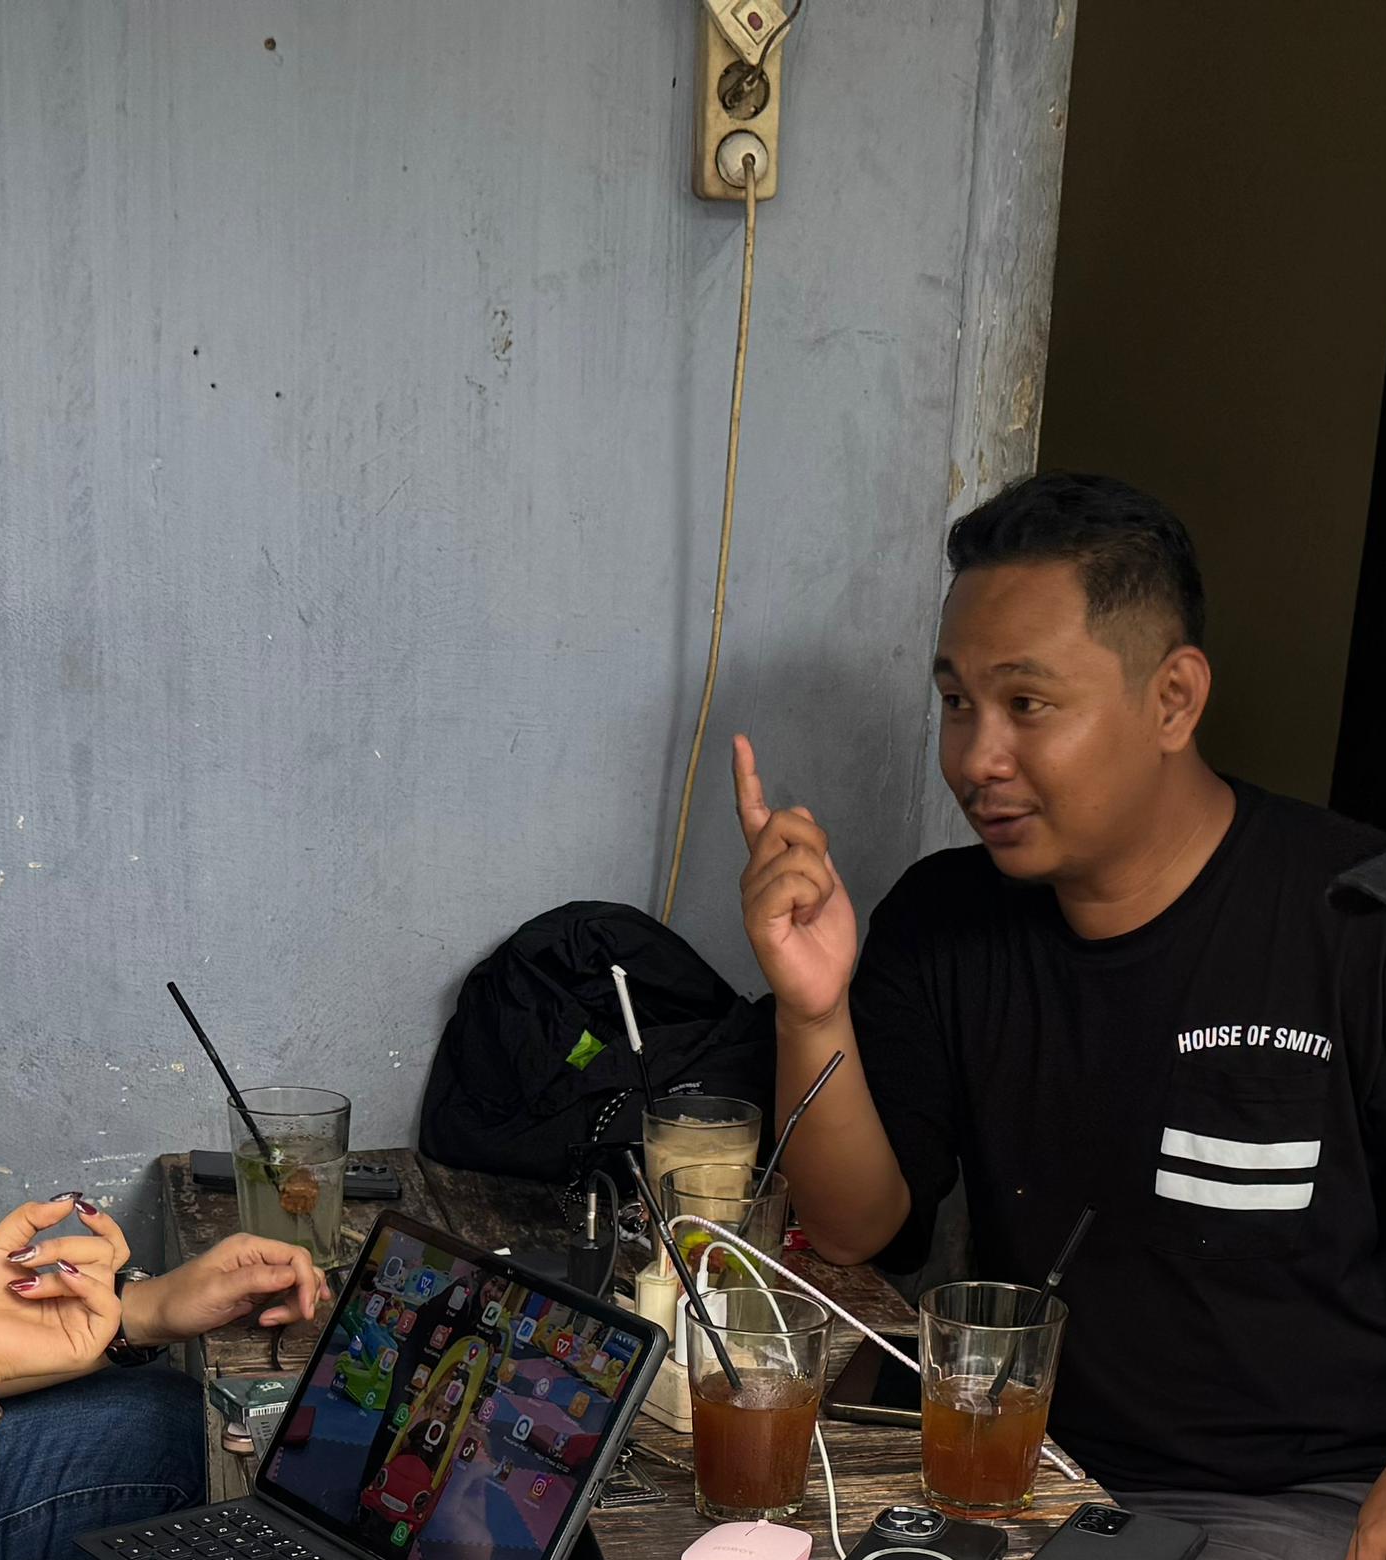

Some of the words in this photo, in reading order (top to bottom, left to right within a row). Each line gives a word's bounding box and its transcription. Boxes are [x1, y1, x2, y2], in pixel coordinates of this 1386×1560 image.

[1177, 1025, 1242, 1054] HOUSE
[1247, 1024, 1271, 1047] OF
[1273, 1027, 1333, 1062] SMITH
